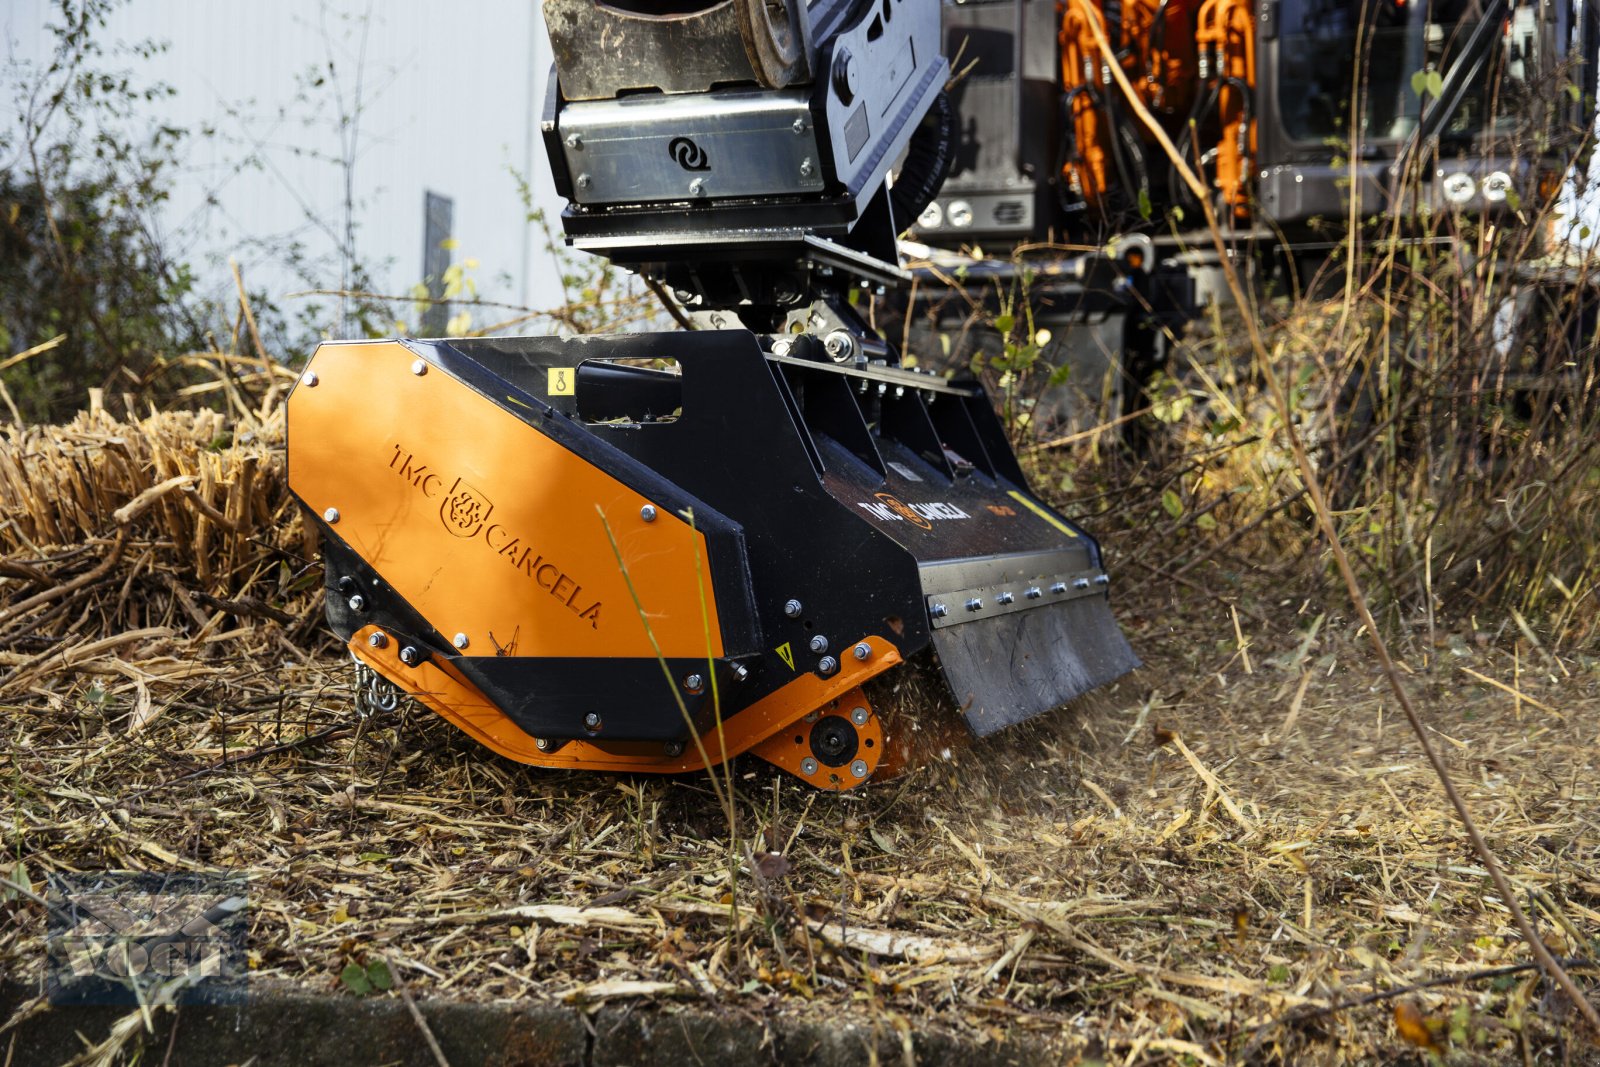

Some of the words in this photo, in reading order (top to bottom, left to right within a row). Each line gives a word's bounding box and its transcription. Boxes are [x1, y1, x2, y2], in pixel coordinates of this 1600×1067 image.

[389, 443, 443, 498] TMC
[485, 523, 603, 630] CANCELA
[857, 502, 904, 521] TMC
[907, 502, 972, 521] CANCELA
